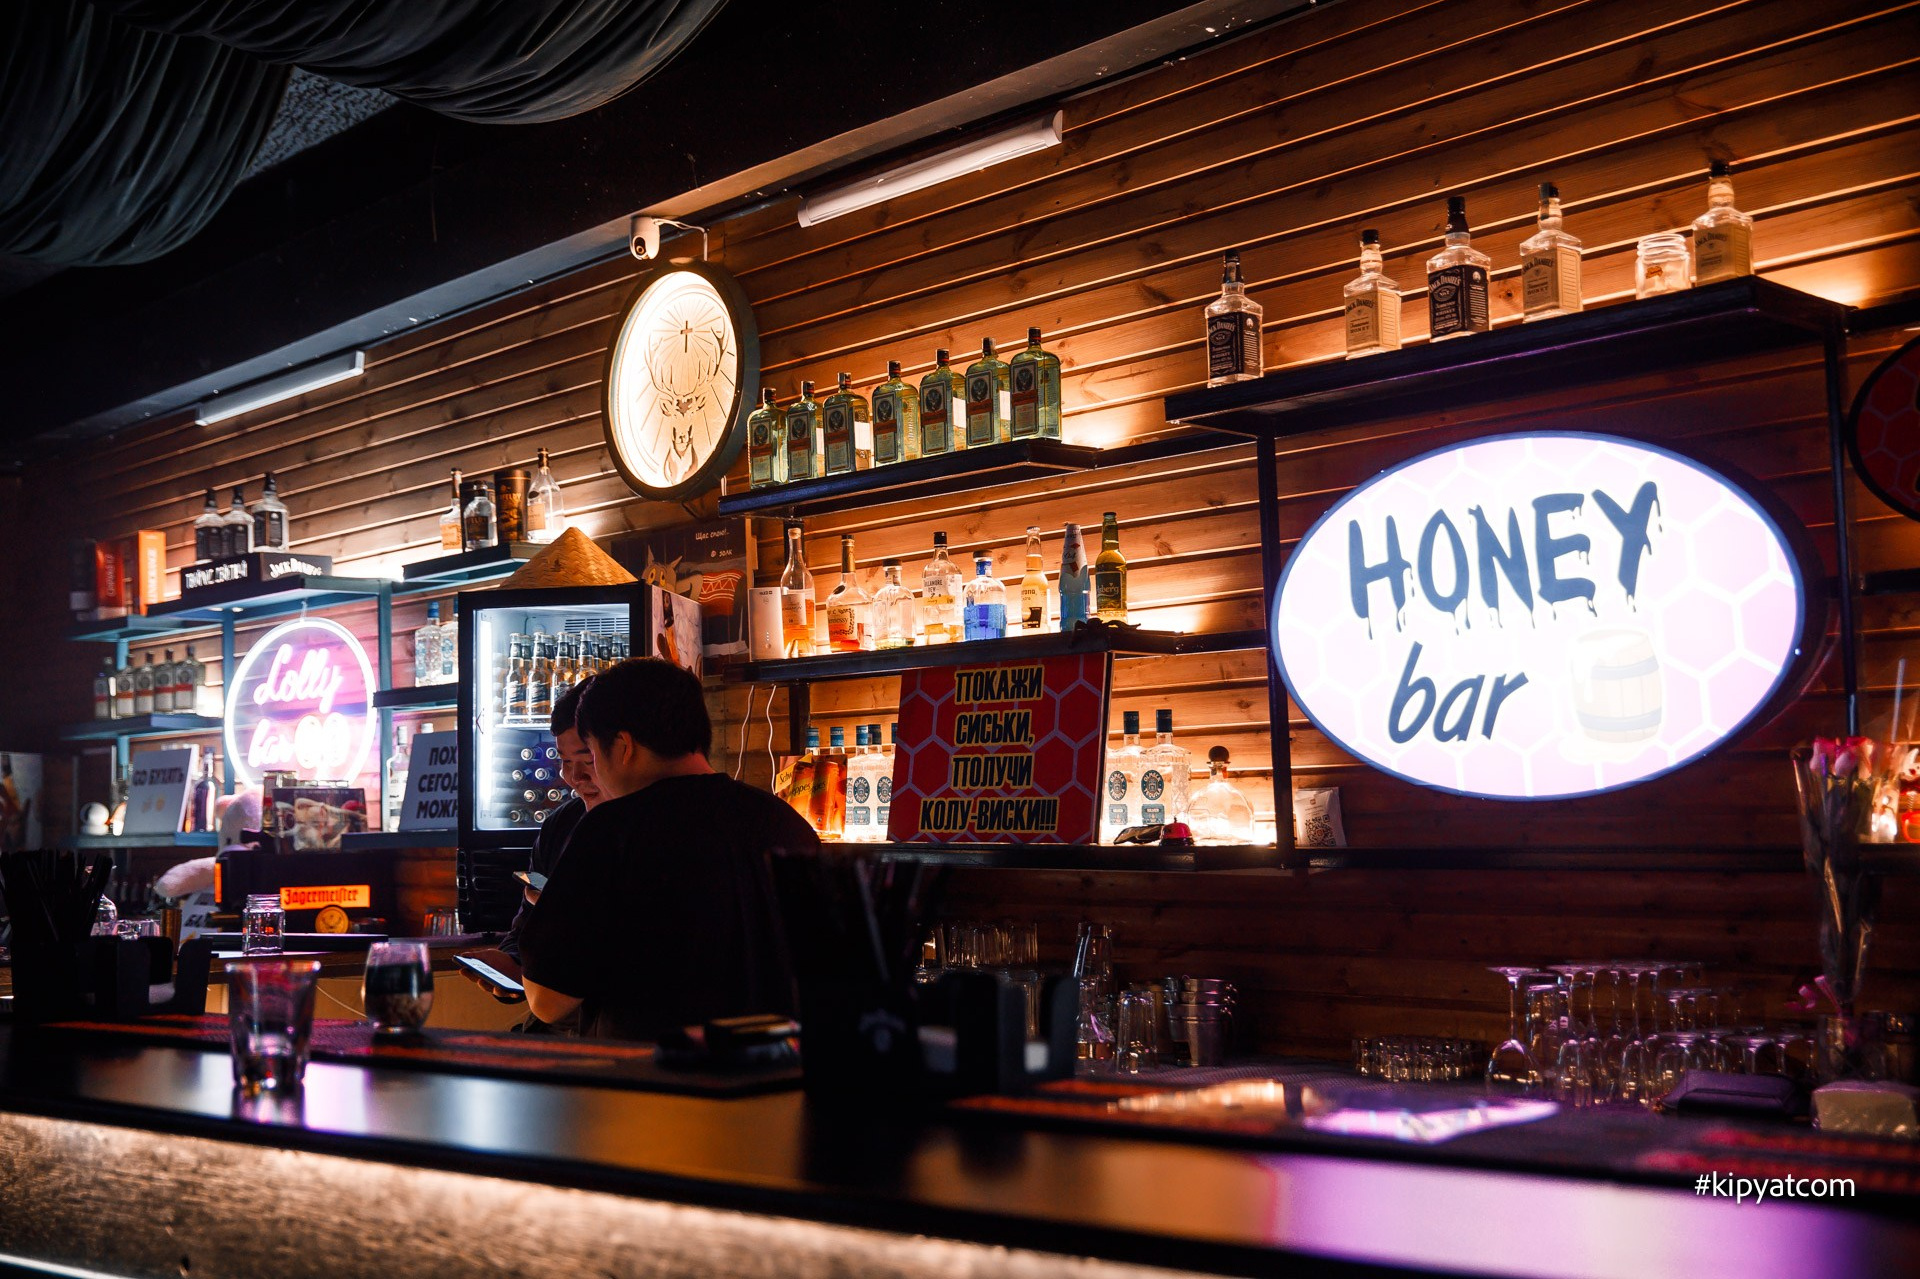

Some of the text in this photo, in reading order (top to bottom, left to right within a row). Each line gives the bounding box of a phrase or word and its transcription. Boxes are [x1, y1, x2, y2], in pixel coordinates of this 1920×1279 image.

[1348, 479, 1664, 640] HONEY
[254, 643, 344, 714] Lolly
[956, 665, 1043, 703] ПОКАЖИ
[1387, 641, 1528, 745] bar
[956, 710, 1032, 746] СИСЬКИ,
[951, 753, 1032, 789] ПОЛУЧИ
[920, 798, 1057, 832] КОЛУ-ВИСКИ!!!
